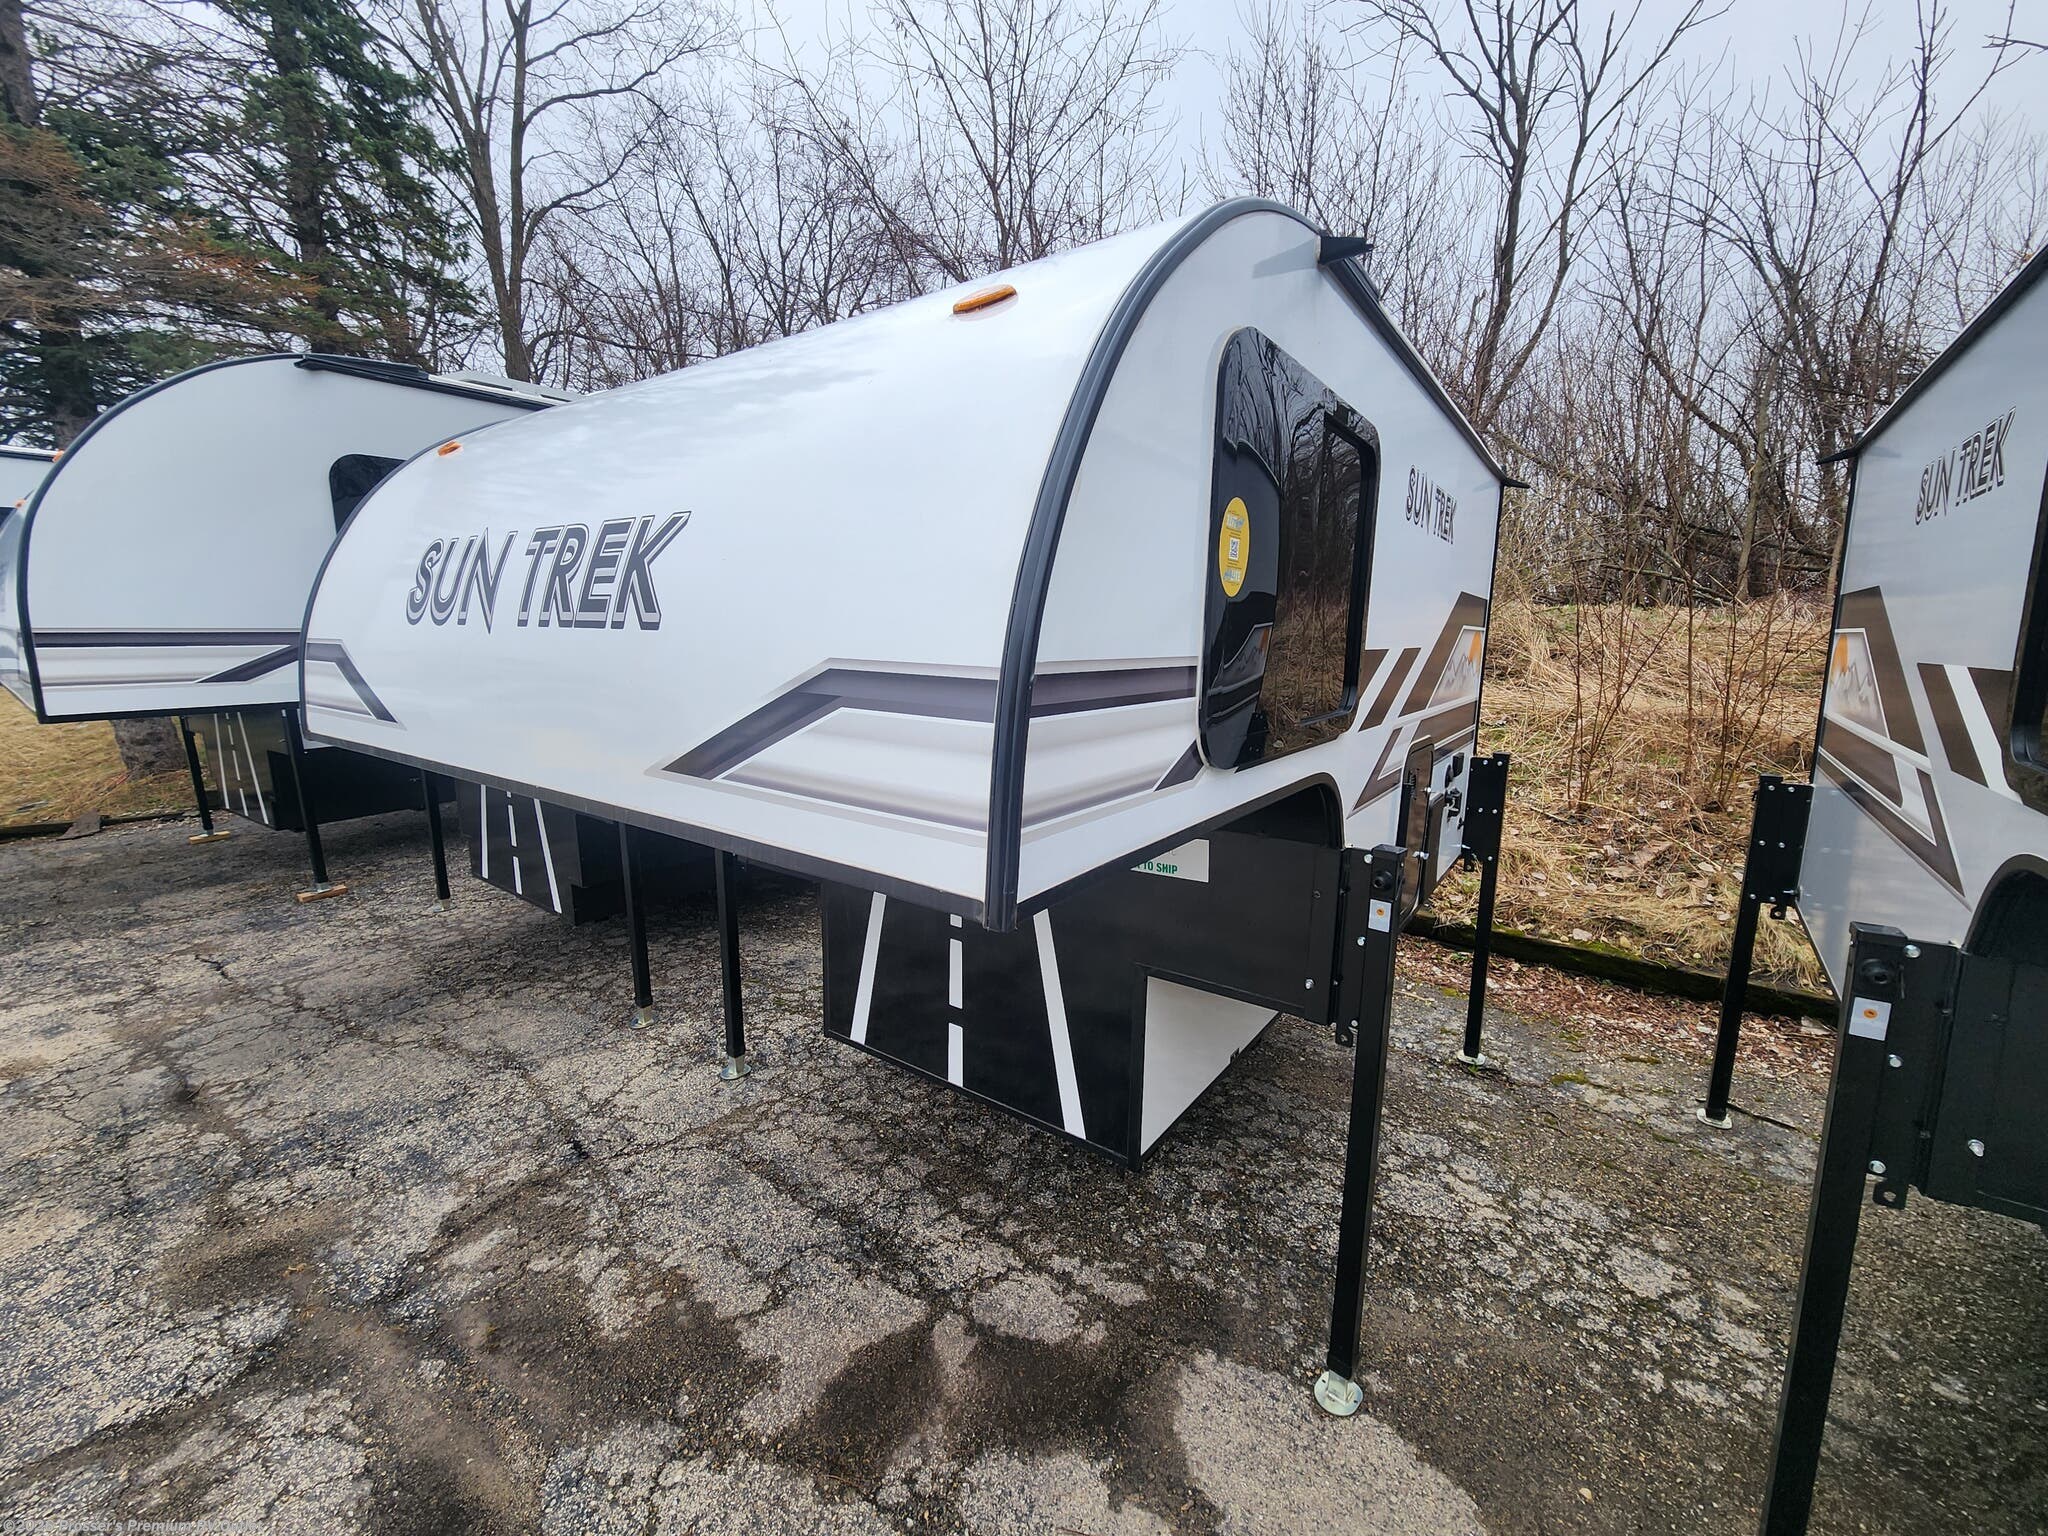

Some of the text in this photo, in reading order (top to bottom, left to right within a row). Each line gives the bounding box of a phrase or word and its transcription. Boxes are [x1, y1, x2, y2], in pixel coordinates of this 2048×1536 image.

[1406, 465, 1457, 545] SUN TREK
[1914, 405, 2016, 526] SUN TREK
[406, 510, 692, 634] SUN TREK
[1144, 861, 1154, 871] TO
[1156, 862, 1178, 874] SHIP
